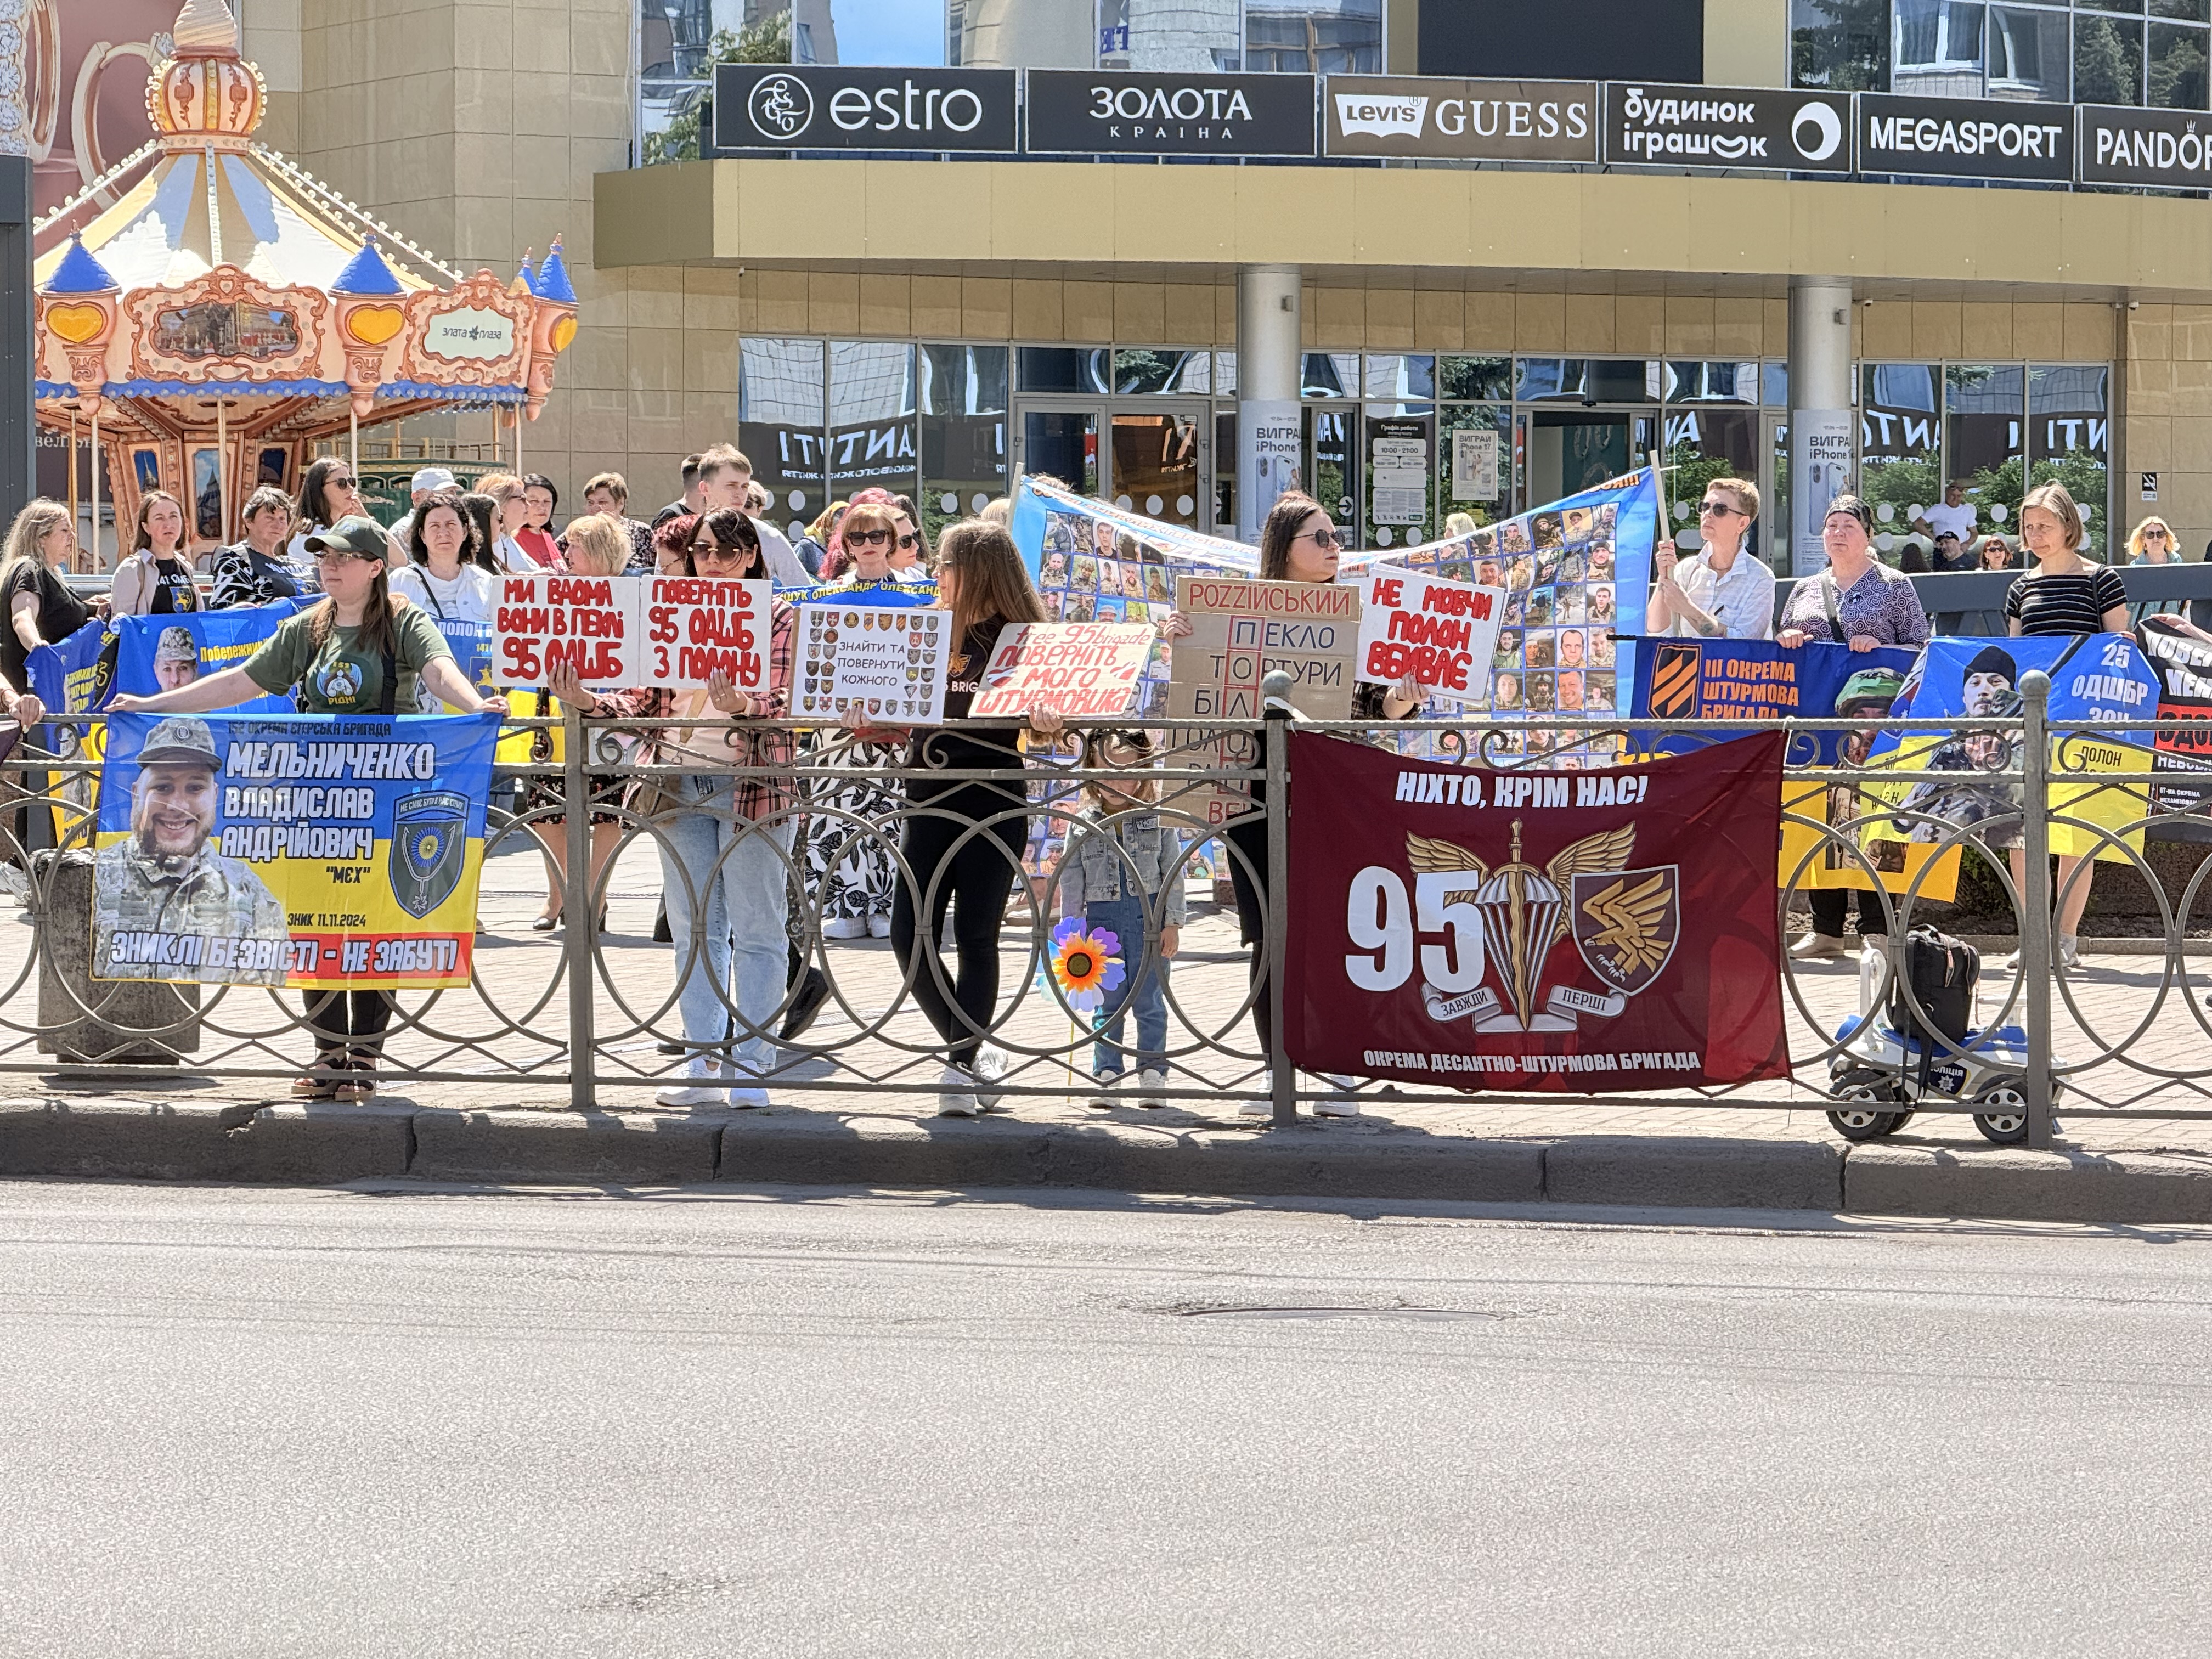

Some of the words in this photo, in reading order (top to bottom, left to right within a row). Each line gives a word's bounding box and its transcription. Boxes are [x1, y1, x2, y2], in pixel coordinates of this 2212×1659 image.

[830, 80, 982, 132] estro
[1089, 86, 1253, 121] ЗОЛОТА
[1624, 88, 1755, 126] будинок
[1435, 99, 1587, 139] GUESS
[1870, 116, 2062, 158] MEGASPORT
[1256, 427, 1301, 439] ВИГРА
[1459, 434, 1491, 442] ВИГРАЙ
[1809, 436, 1851, 447] ВИГРА
[1256, 441, 1296, 452] iPhone
[1809, 448, 1847, 459] iPhone
[504, 579, 535, 603] МИ
[811, 582, 877, 600] ОЛЕКСАНДР
[1372, 577, 1404, 607] НЕ
[1422, 585, 1493, 621] МОВЧИ
[438, 622, 483, 637] ПОЛОН
[497, 607, 549, 635] ВОНИ
[648, 606, 679, 643] 95
[1387, 610, 1472, 651] ПОЛОН
[839, 640, 885, 653] ЗНАЙТИ
[890, 644, 905, 654] ТА
[1017, 625, 1055, 645] free
[1235, 621, 1335, 649] ПЕКЛО
[502, 636, 541, 680] 95
[837, 657, 905, 670] ПОВЕРНУТИ
[2101, 644, 2131, 669] 25
[841, 674, 898, 686] КОЖНОГО
[1021, 667, 1101, 689] МОГО
[1726, 659, 1796, 682] ОКРЕМА
[1702, 681, 1799, 707] ШТУРМОВА
[2071, 674, 2148, 706] ОДШБР
[1194, 689, 1262, 718] БІЛ
[228, 722, 245, 735] 152
[248, 722, 287, 735] ОКРЕМА
[343, 722, 391, 737] БРИГАДА
[225, 741, 436, 781] МЕЛЬНИЧЕНКО
[1395, 771, 1487, 809] НІХТО,
[1493, 776, 1569, 808] КРІМ
[1576, 775, 1649, 808] НАС!
[223, 786, 375, 822] ВЛАДИСЛАВ
[219, 820, 375, 863] АНДРІЙОВИЧ
[287, 913, 314, 927] ЗНИК
[317, 913, 366, 927] 11.11.2024
[1345, 865, 1486, 994] 95
[110, 931, 204, 967] ЗНИКЛІ
[206, 937, 320, 973] БЕЗВІСТІ
[340, 939, 372, 973] НЕ
[373, 938, 459, 973] ЗАБУТІ
[1440, 990, 1488, 1018] ЗАВЖДИ
[1562, 989, 1607, 1011] ПЕРШІ
[1364, 1050, 1428, 1070] ОКРЕМА
[1431, 1053, 1618, 1073] ДЕСАНТНО-ШТУРМОВА
[1620, 1052, 1701, 1070] БРИГАДА
[1930, 1066, 1963, 1077] ОЛІЦІЯ
